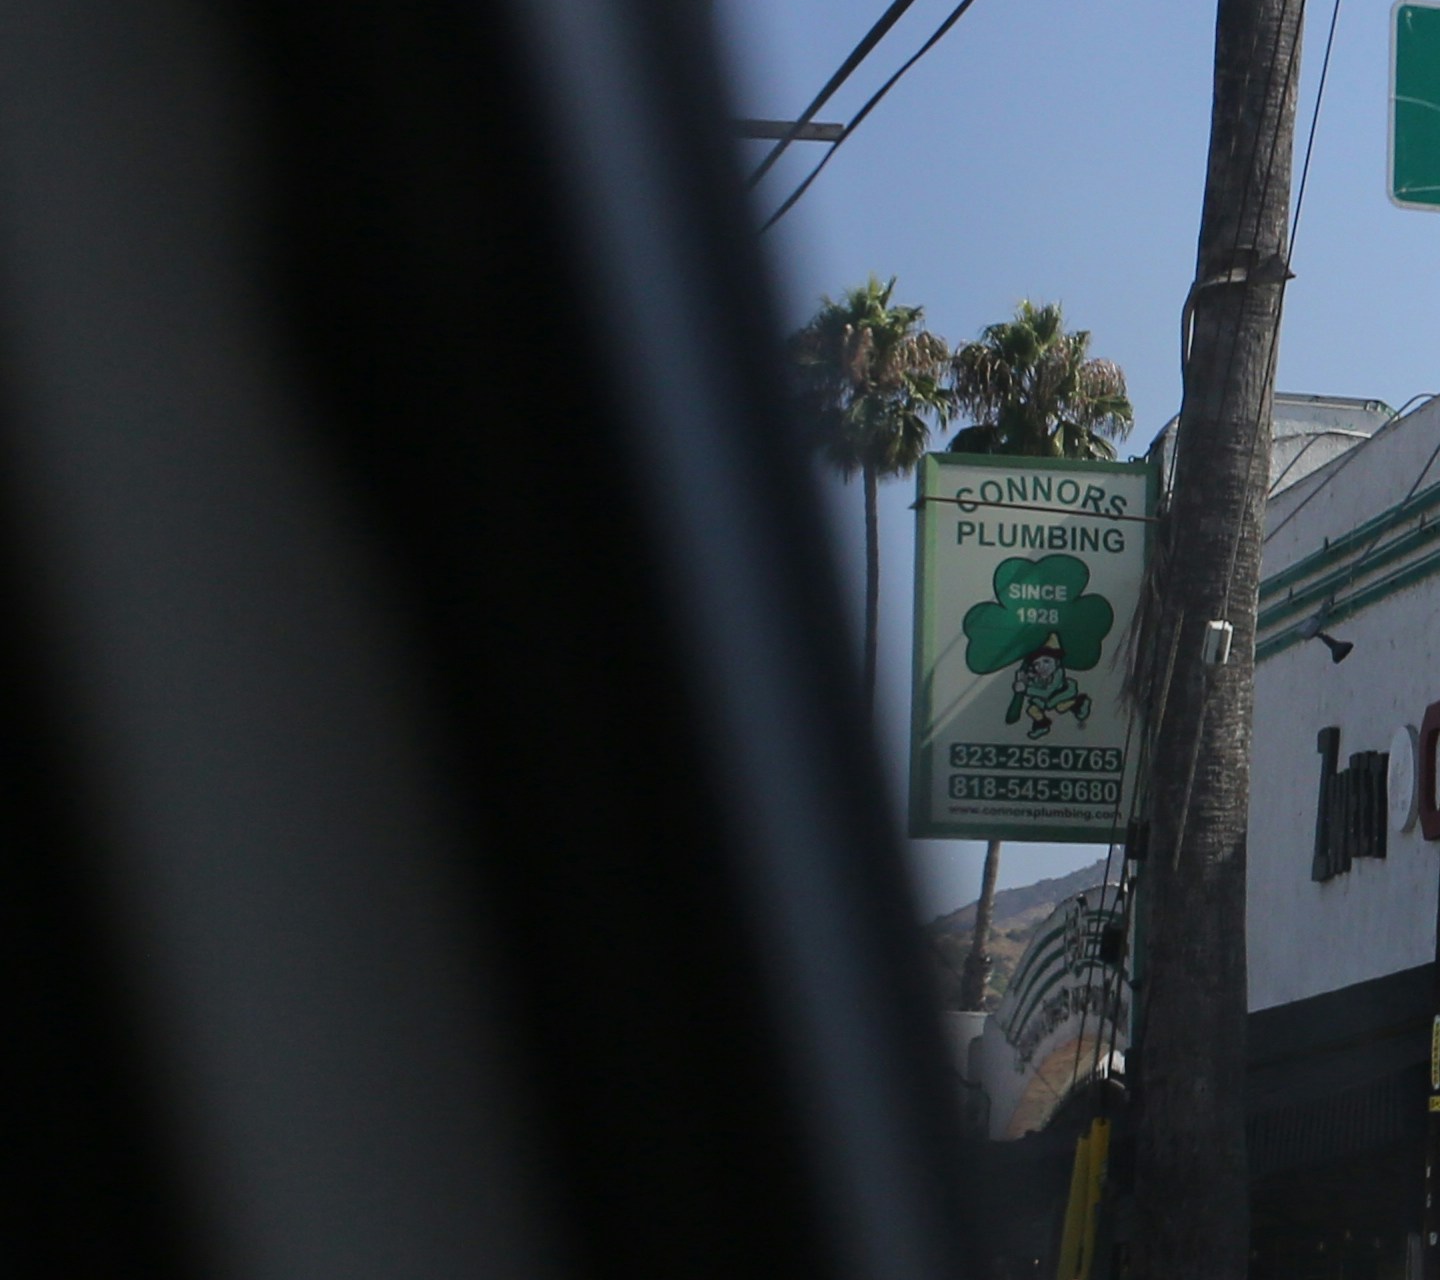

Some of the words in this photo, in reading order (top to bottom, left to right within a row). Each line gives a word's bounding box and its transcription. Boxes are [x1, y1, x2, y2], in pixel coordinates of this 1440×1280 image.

[956, 474, 1128, 521] CONNORS
[957, 520, 1126, 554] PLUMBING
[1008, 582, 1068, 602] SINCE
[1016, 607, 1060, 626] 1928
[953, 745, 1120, 771] 323-256-0765
[952, 775, 1119, 803] 818-545-9680
